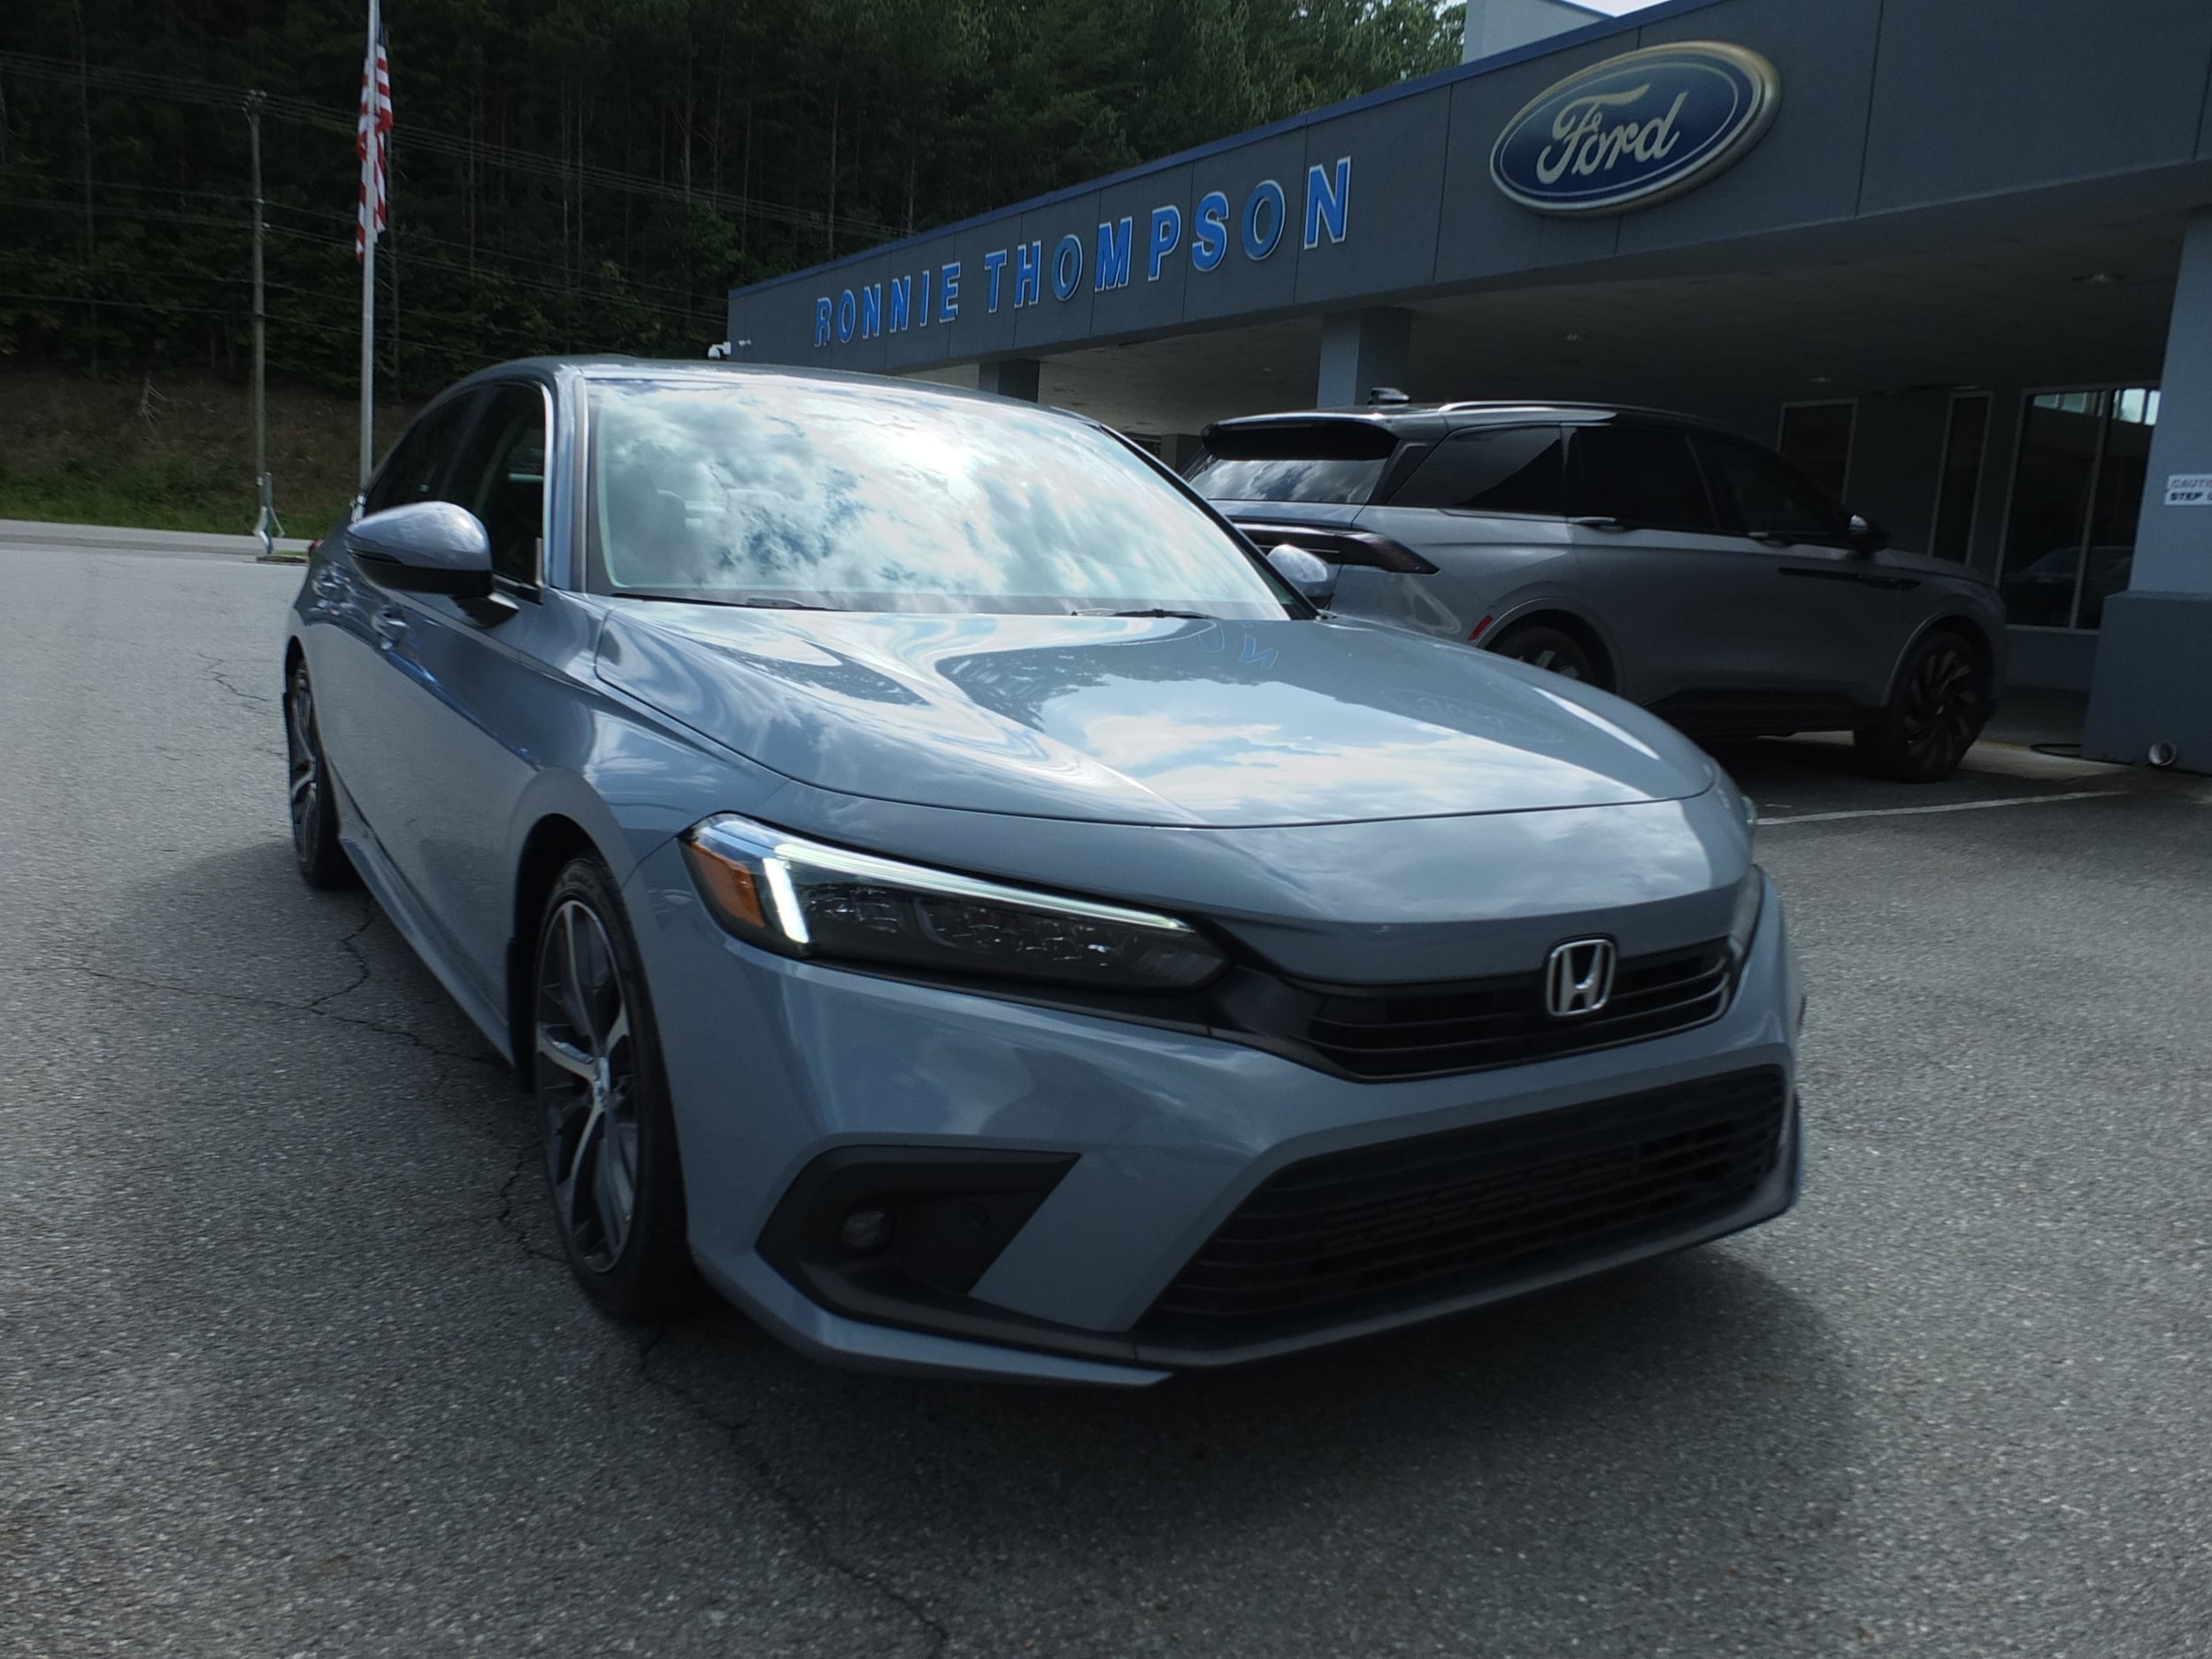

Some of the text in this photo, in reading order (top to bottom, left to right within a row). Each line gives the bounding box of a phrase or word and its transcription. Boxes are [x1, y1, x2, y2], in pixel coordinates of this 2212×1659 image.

[1536, 83, 1689, 184] Ford
[814, 156, 1352, 348] RONNIE THOMPSON
